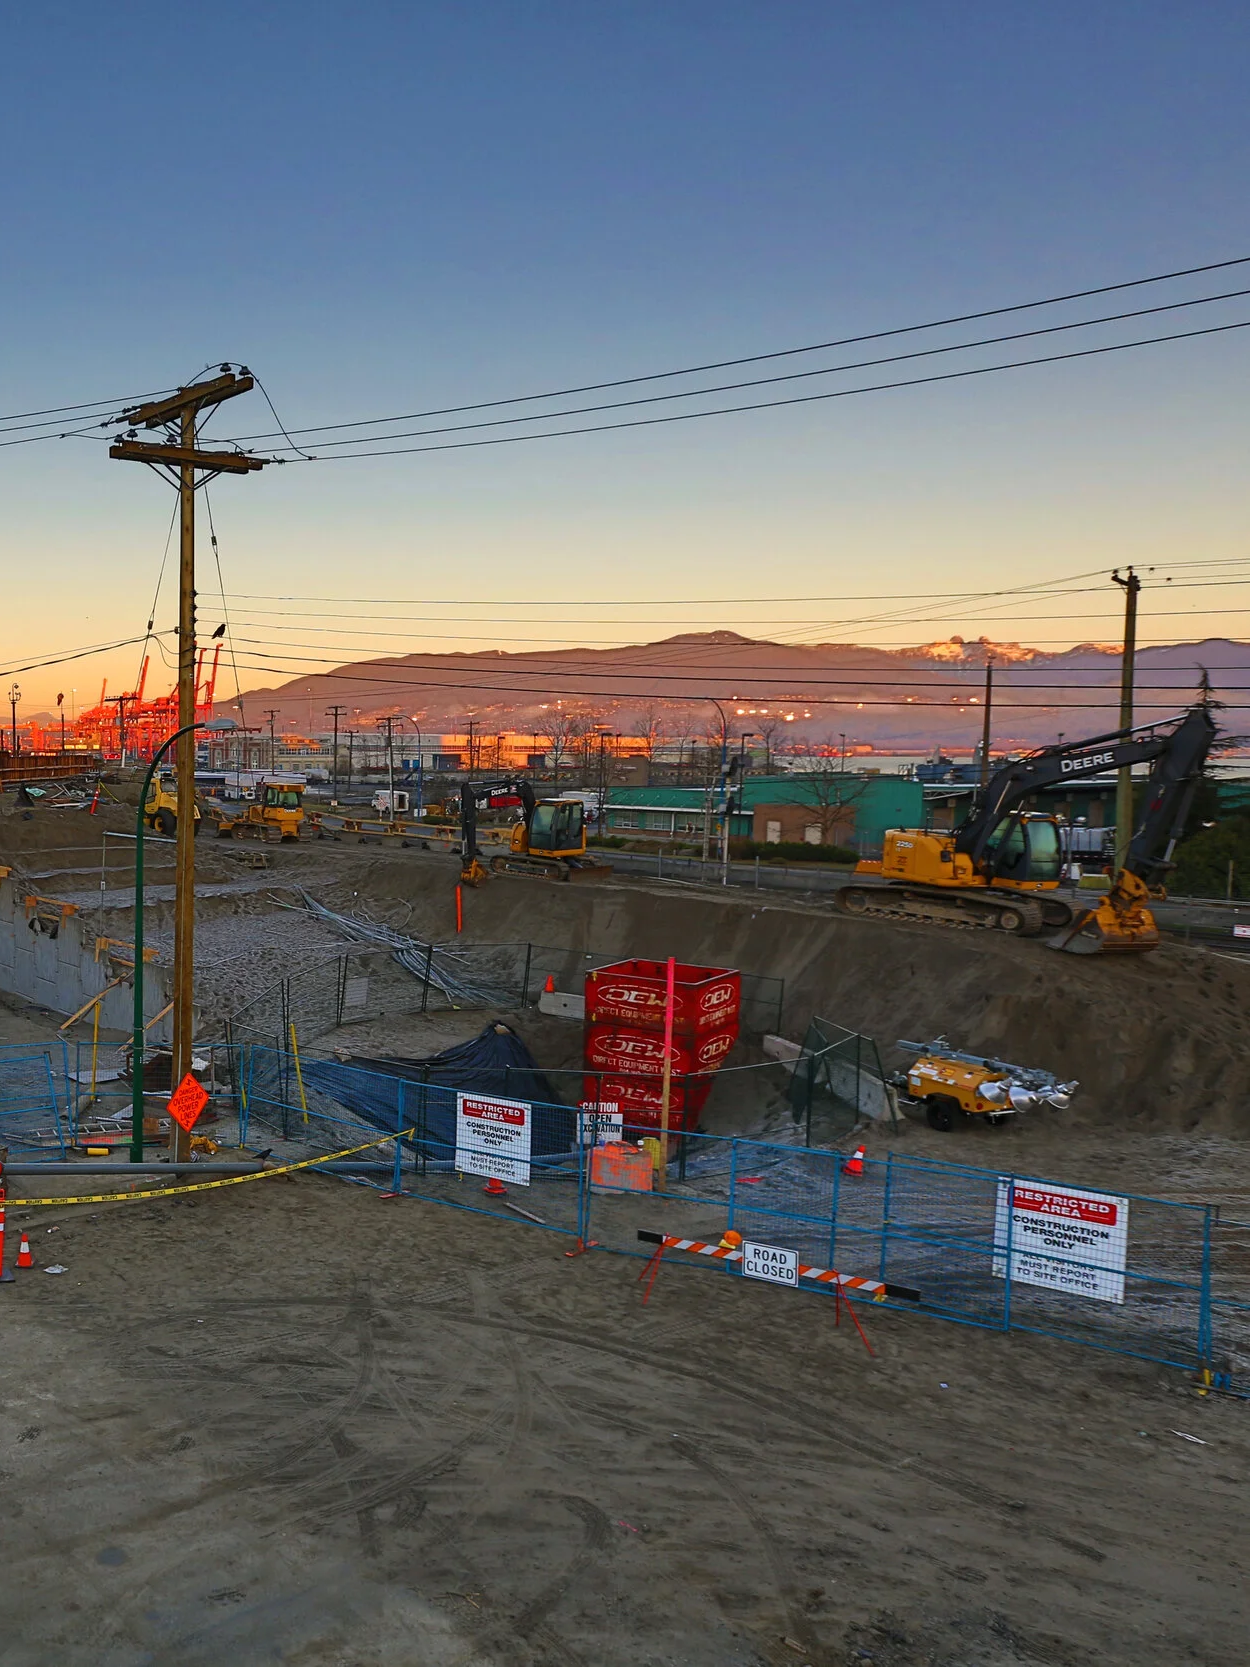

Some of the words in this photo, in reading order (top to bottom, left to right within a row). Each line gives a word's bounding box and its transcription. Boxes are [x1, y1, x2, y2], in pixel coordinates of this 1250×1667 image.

[1061, 752, 1114, 773] DEERE
[491, 788, 508, 796] DEERE
[619, 1060, 659, 1074] EQUIPMENT
[173, 1092, 203, 1106] OVERHEAD
[178, 1101, 199, 1112] POWER
[466, 1101, 521, 1117] RESTRICTED
[181, 1111, 196, 1121] LINES
[481, 1111, 505, 1121] AREA
[589, 1114, 612, 1123] OPEN
[466, 1121, 521, 1137] CONSTRUCTION
[472, 1129, 514, 1143] PERSONNEL
[484, 1138, 502, 1147] ONLY
[470, 1155, 487, 1164] MUST
[490, 1159, 514, 1169] REPORT
[478, 1164, 492, 1172] SITE
[494, 1167, 516, 1177] OFFICE
[1014, 1189, 1111, 1214] RESTRICTED
[1040, 1204, 1082, 1218] AREA
[1013, 1214, 1110, 1240] CONSTRUCTION
[1023, 1225, 1098, 1246] PERSONNEL
[1043, 1237, 1075, 1250] ONLY
[754, 1248, 787, 1265] ROAD
[746, 1260, 794, 1280] CLOSED
[1020, 1259, 1048, 1272] MUST
[1052, 1265, 1097, 1281] REPORT
[1016, 1267, 1031, 1276] TO
[1033, 1270, 1056, 1281] SITE
[1059, 1276, 1099, 1291] OFFICE
